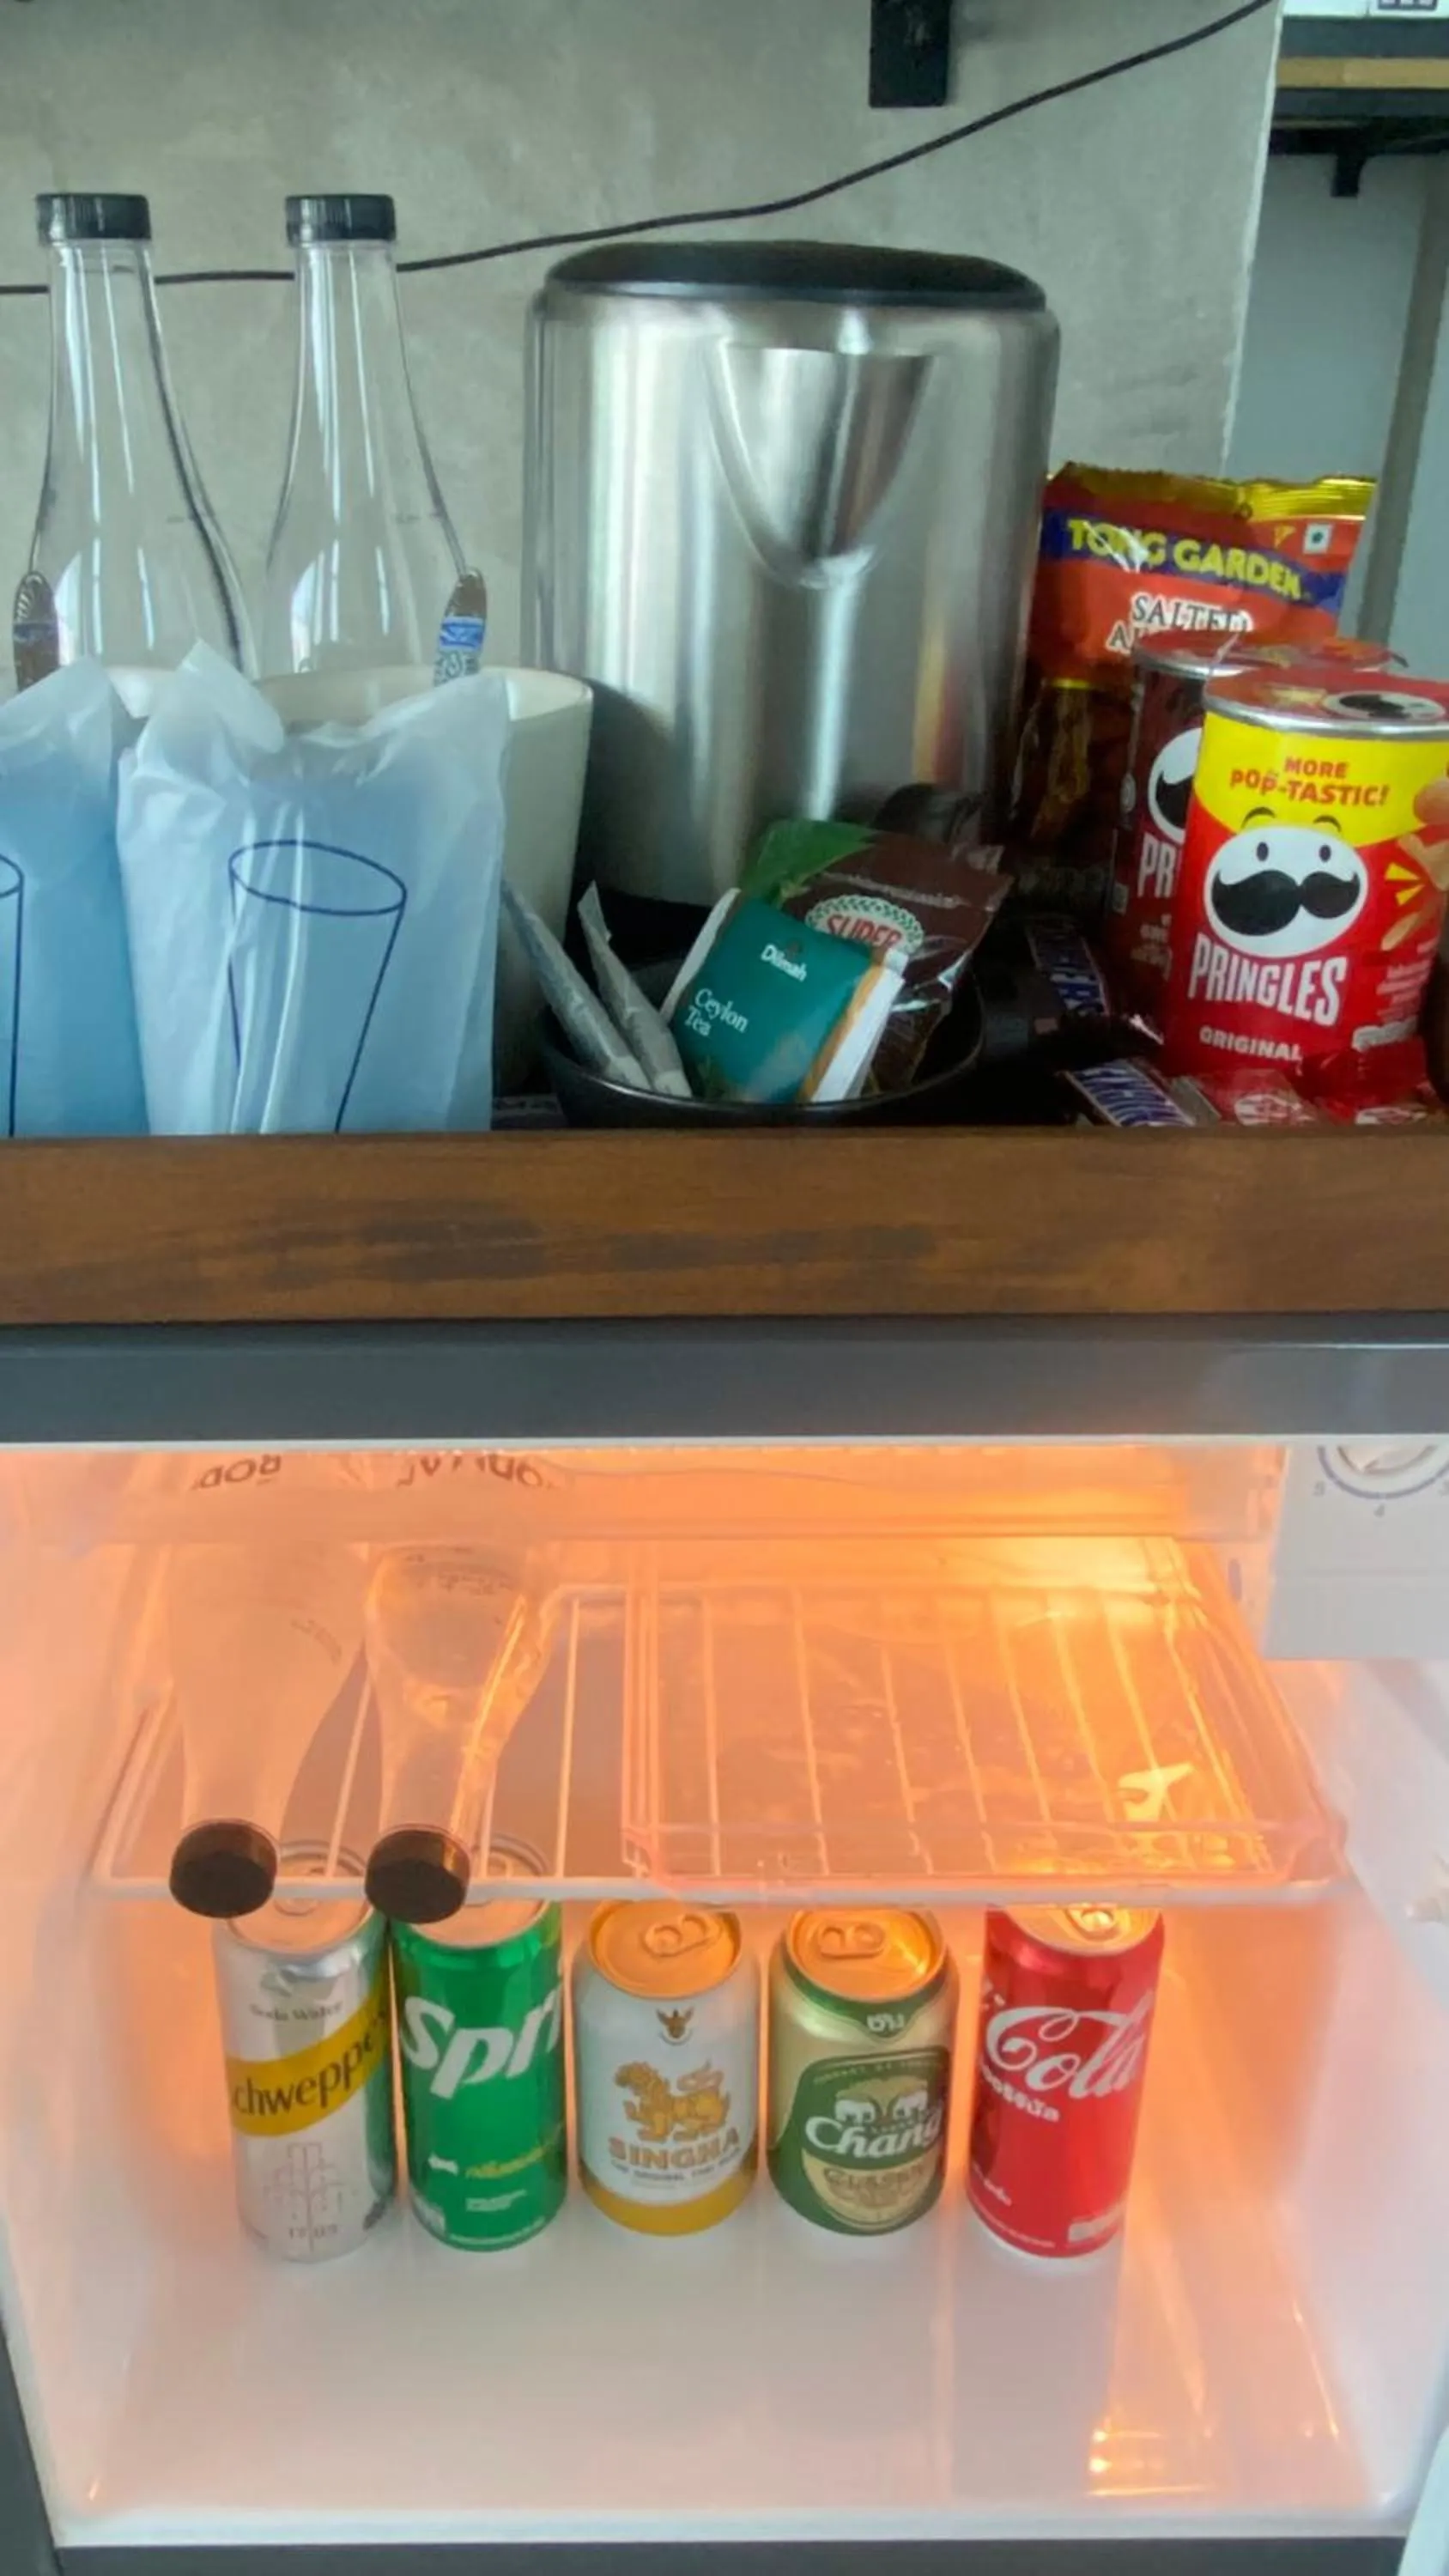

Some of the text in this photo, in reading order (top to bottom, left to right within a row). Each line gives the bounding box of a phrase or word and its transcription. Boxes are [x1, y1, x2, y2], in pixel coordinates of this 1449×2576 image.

[1173, 538, 1300, 599] GARDEN
[1284, 756, 1349, 779] MORE
[1187, 931, 1349, 1027] PRINGLES
[684, 1005, 712, 1036] Tea
[694, 988, 749, 1033] Ceylon
[1199, 1024, 1303, 1062] ORIGINAL
[607, 2127, 740, 2170] SINGHA
[804, 2105, 943, 2159] Chang
